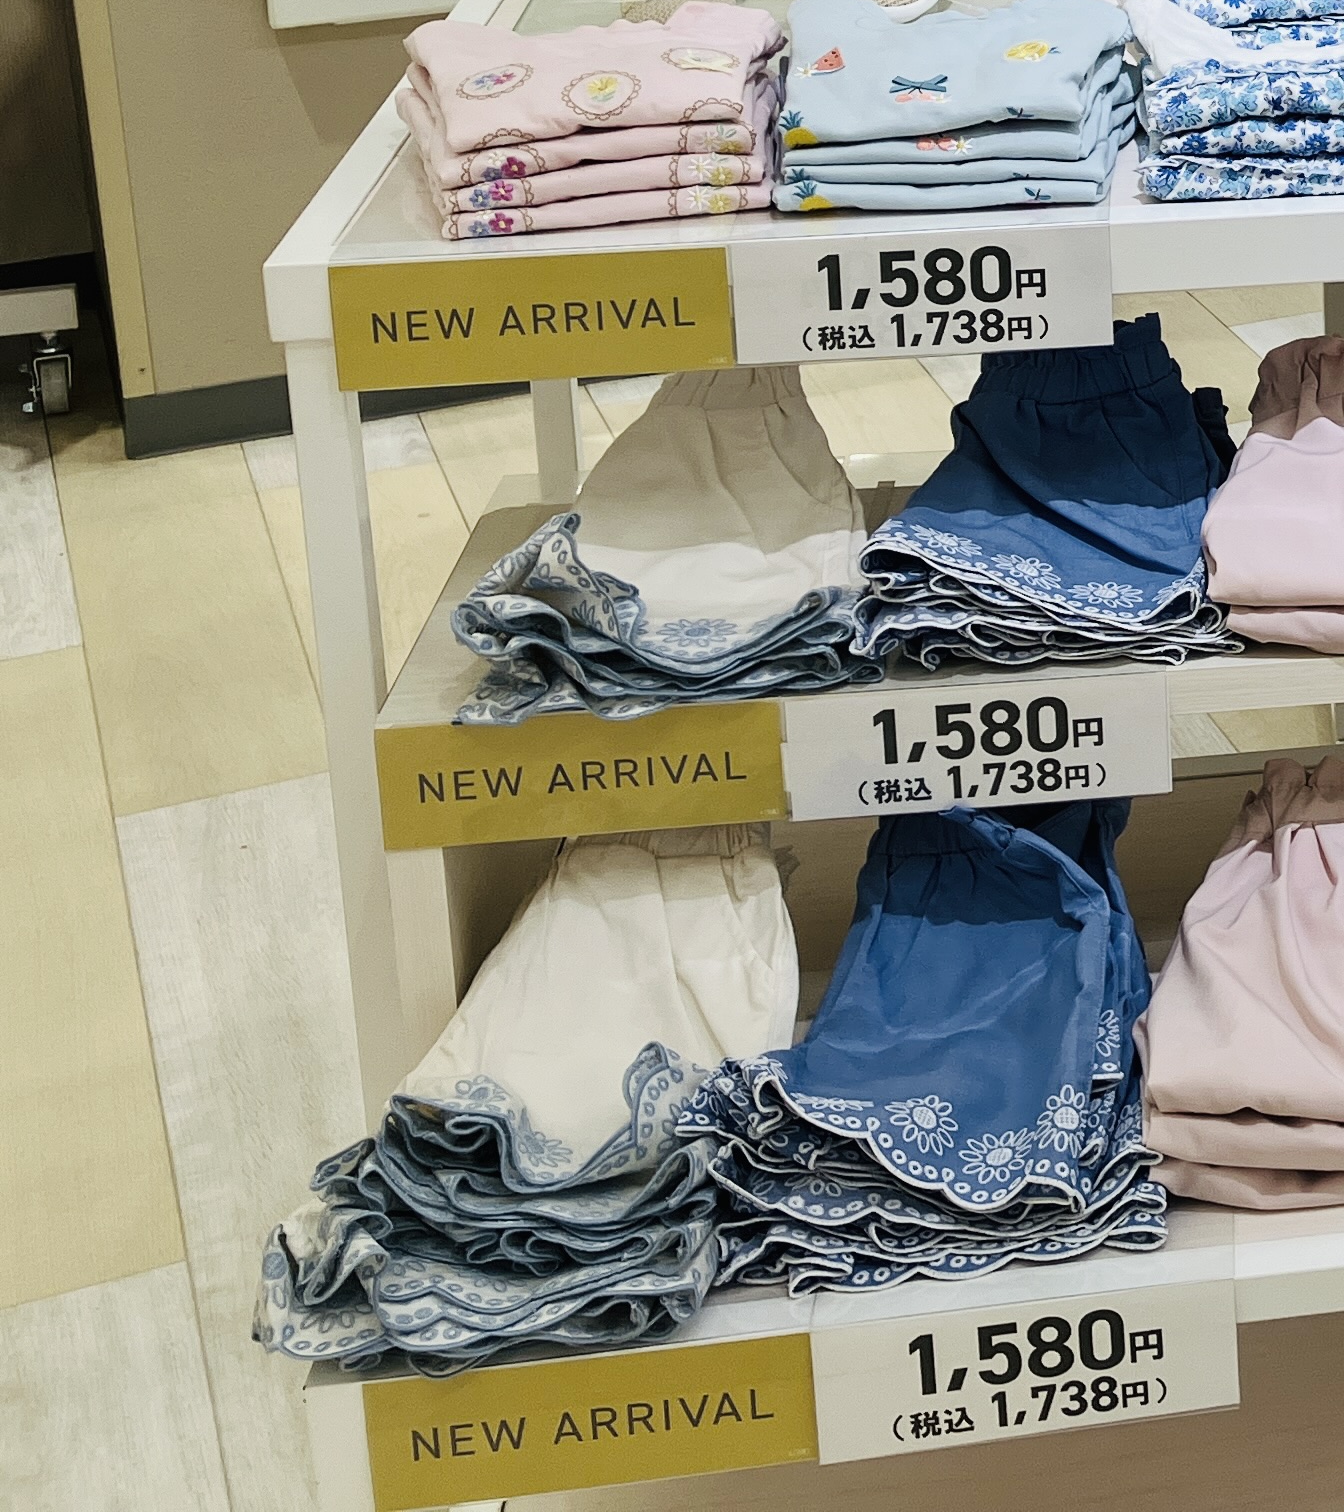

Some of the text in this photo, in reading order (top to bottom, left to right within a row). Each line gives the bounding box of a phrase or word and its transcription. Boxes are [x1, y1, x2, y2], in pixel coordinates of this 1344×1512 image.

[816, 245, 1048, 312] 1,580円
[371, 294, 697, 345] NEW ARRIVAL
[872, 696, 1105, 767] 1,580円
[417, 750, 747, 804] NEW ARRIVAL
[908, 1308, 1163, 1398] 1,580円
[410, 1387, 775, 1464] NEW ARRIVAL
